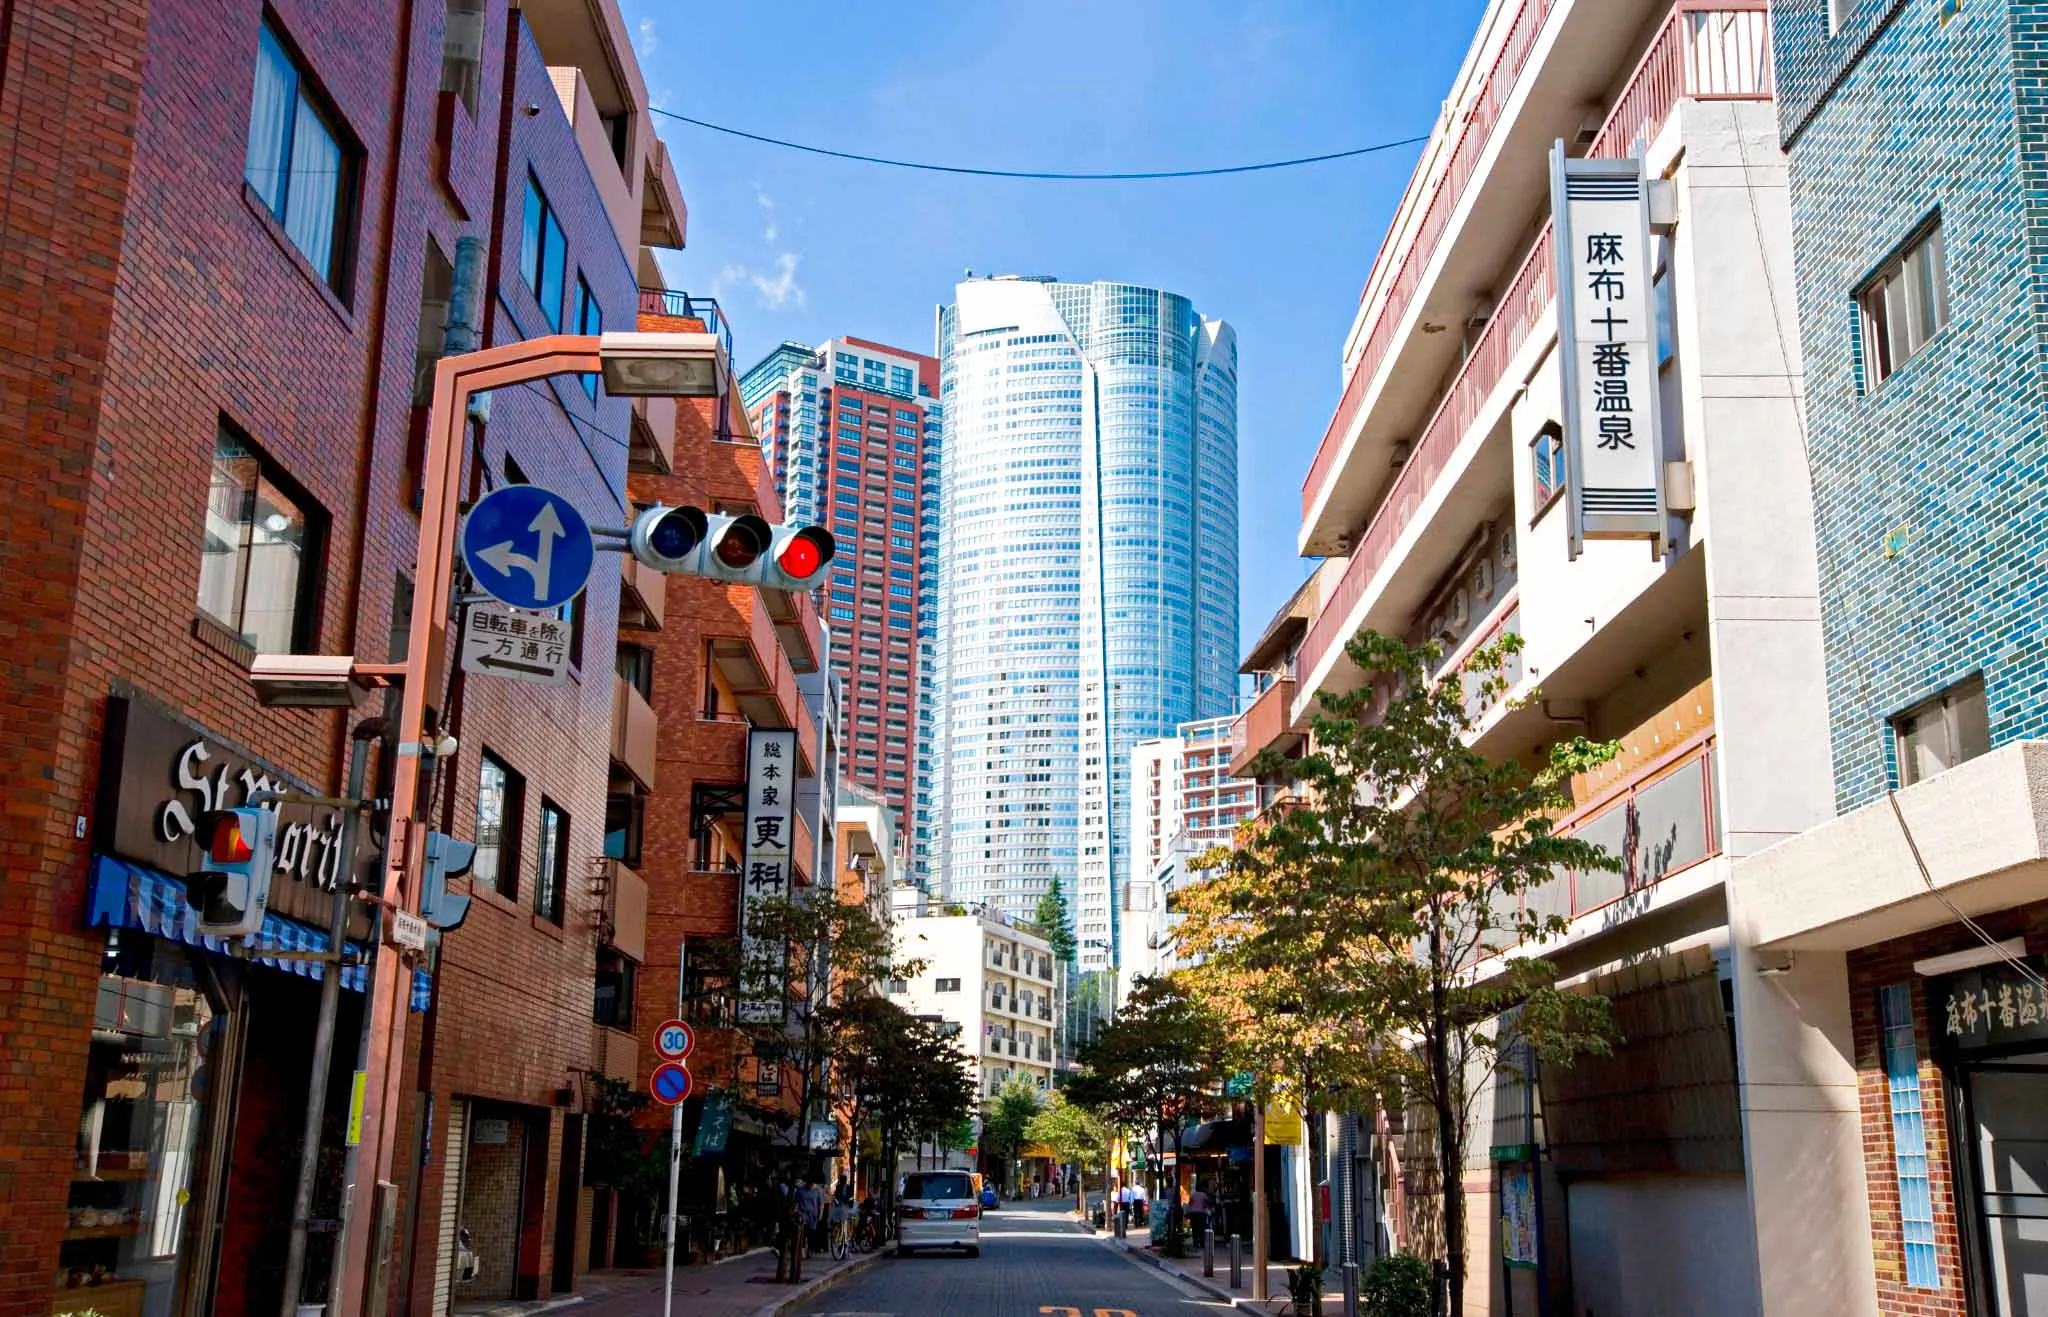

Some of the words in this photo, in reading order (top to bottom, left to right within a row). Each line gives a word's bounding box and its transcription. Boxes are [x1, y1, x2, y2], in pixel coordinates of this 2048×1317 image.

[1586, 232, 1635, 450] 麻布十番温泉
[472, 611, 565, 642] 自転車を除く
[471, 638, 563, 665] 一方通行
[240, 768, 360, 902] Morit
[663, 1031, 686, 1050] 30
